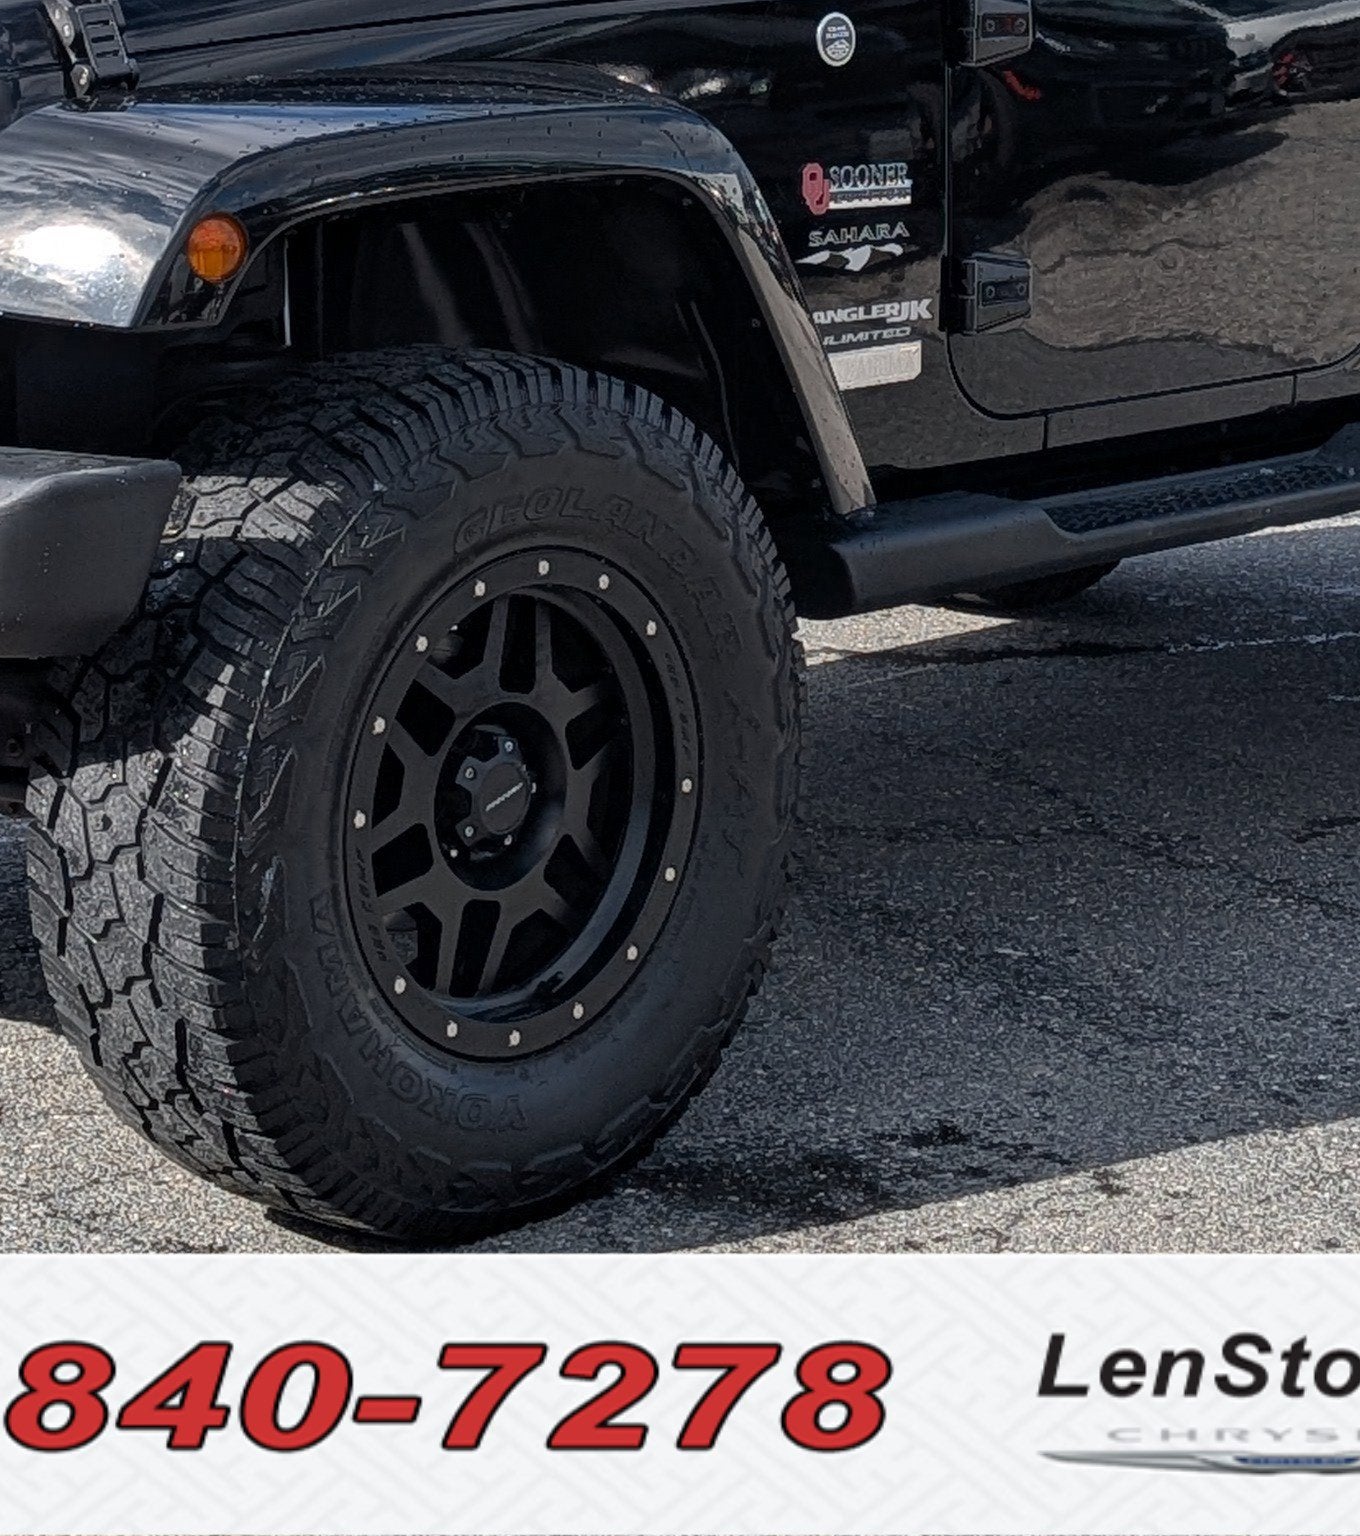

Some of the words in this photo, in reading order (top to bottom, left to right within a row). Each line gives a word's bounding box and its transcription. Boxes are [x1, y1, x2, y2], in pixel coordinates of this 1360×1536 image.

[829, 162, 909, 189] SOONER
[808, 221, 911, 247] SAHARA
[822, 326, 912, 346] LIMITED
